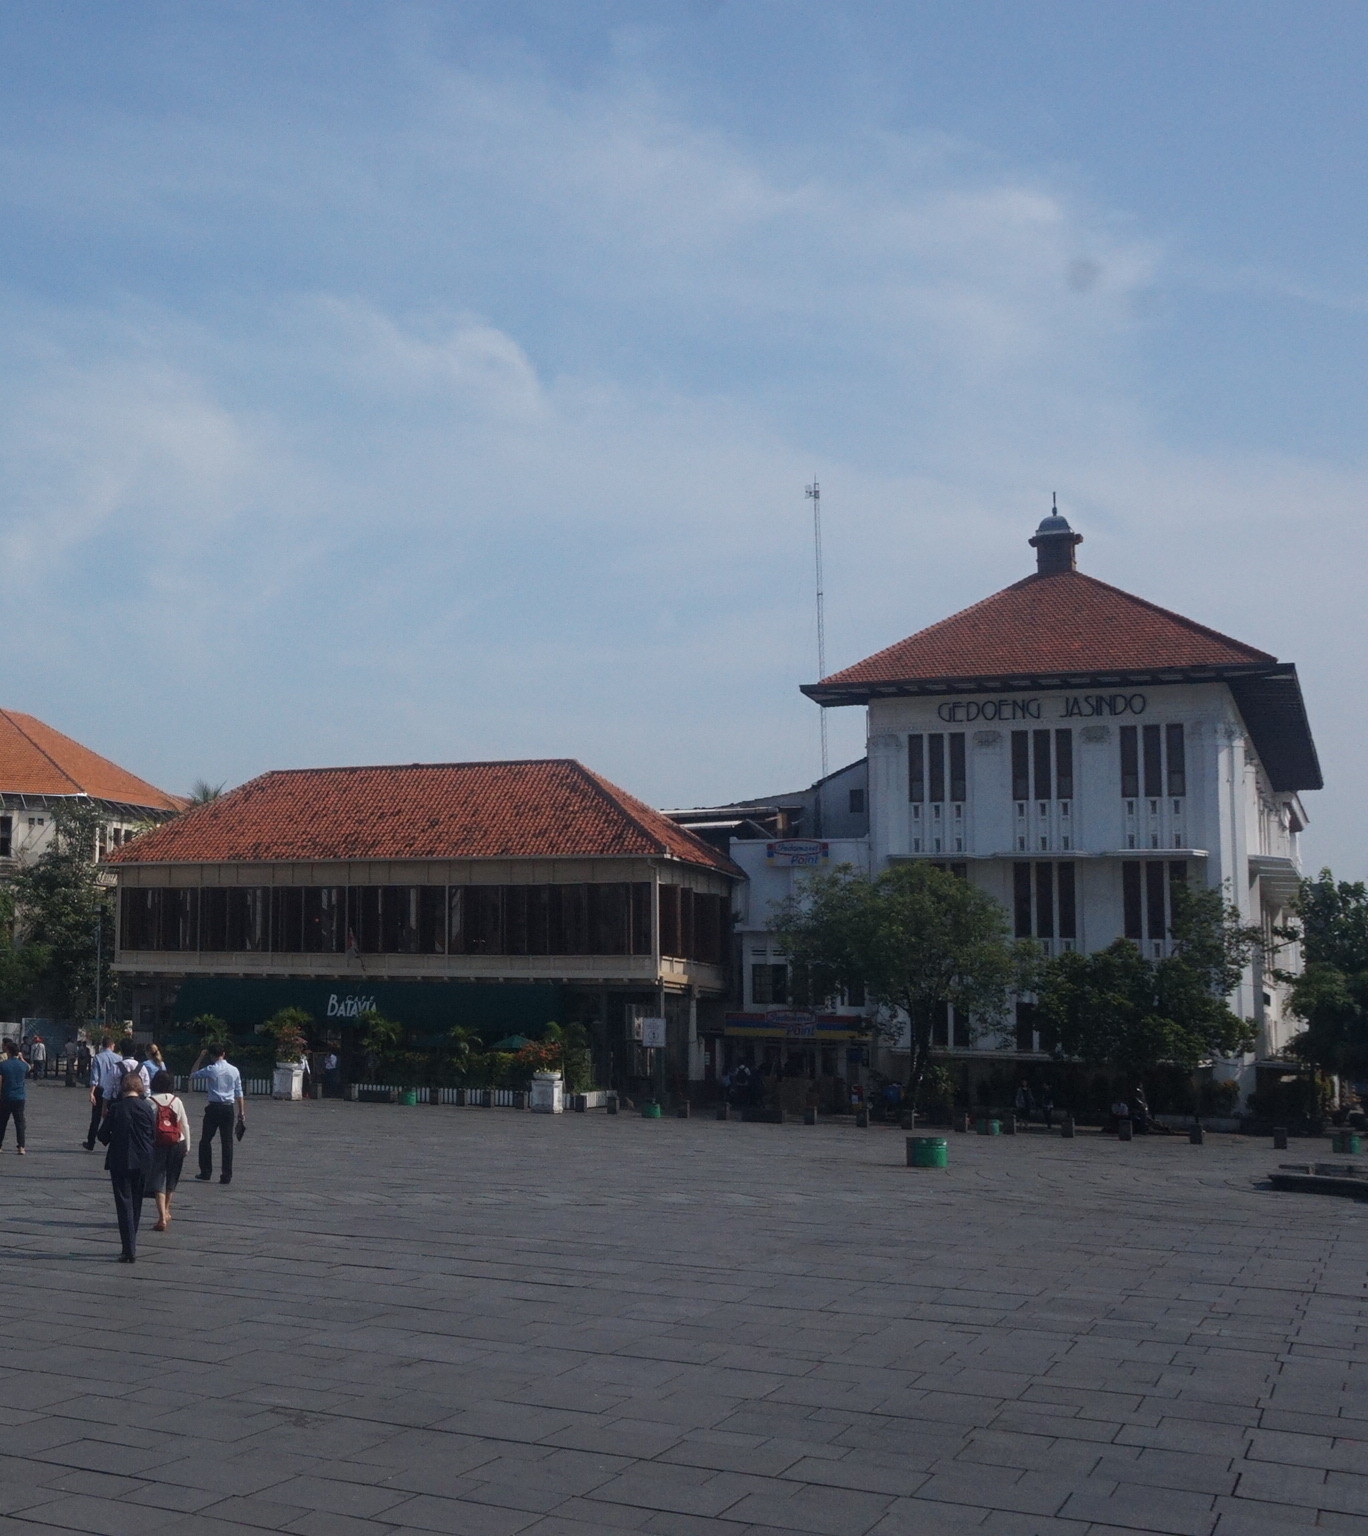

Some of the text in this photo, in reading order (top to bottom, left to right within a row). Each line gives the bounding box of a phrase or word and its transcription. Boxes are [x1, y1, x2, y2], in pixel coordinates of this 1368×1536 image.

[937, 693, 1147, 723] GEDOENG JASINDO
[790, 855, 819, 865] Point
[786, 1025, 816, 1036] Point
